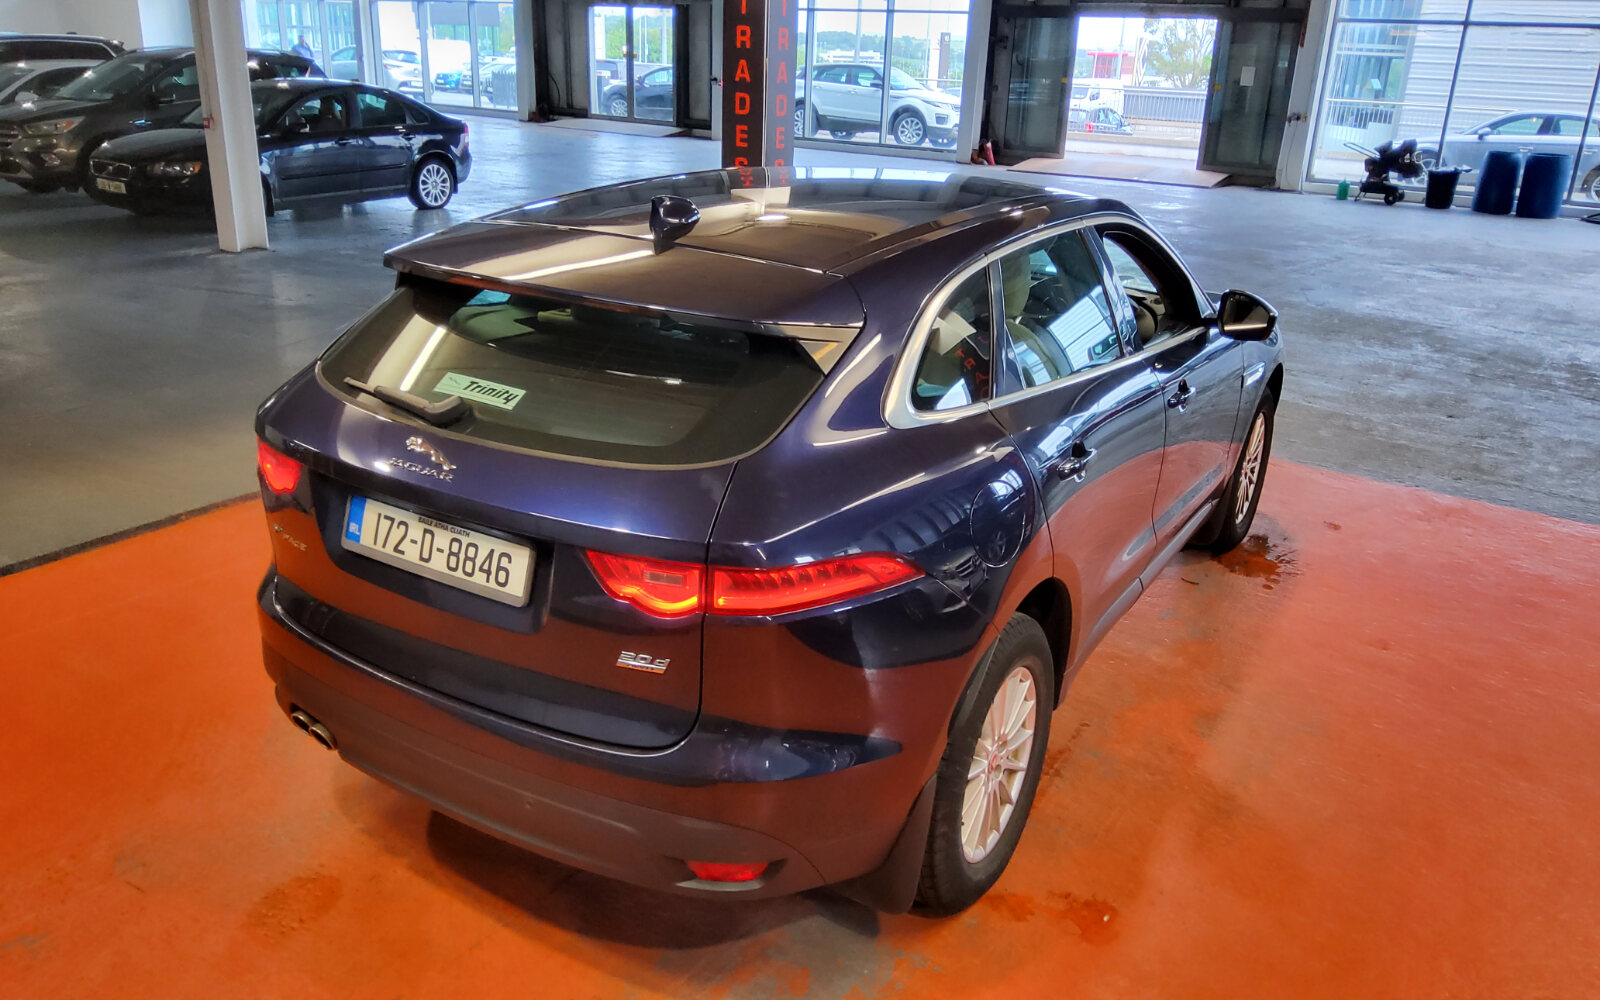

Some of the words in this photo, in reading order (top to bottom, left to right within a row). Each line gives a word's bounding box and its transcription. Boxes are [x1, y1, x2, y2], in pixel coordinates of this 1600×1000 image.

[462, 380, 520, 405] Trinity
[386, 456, 454, 484] JAGUAR
[349, 522, 361, 535] IRL
[373, 512, 513, 588] 172-D-8846
